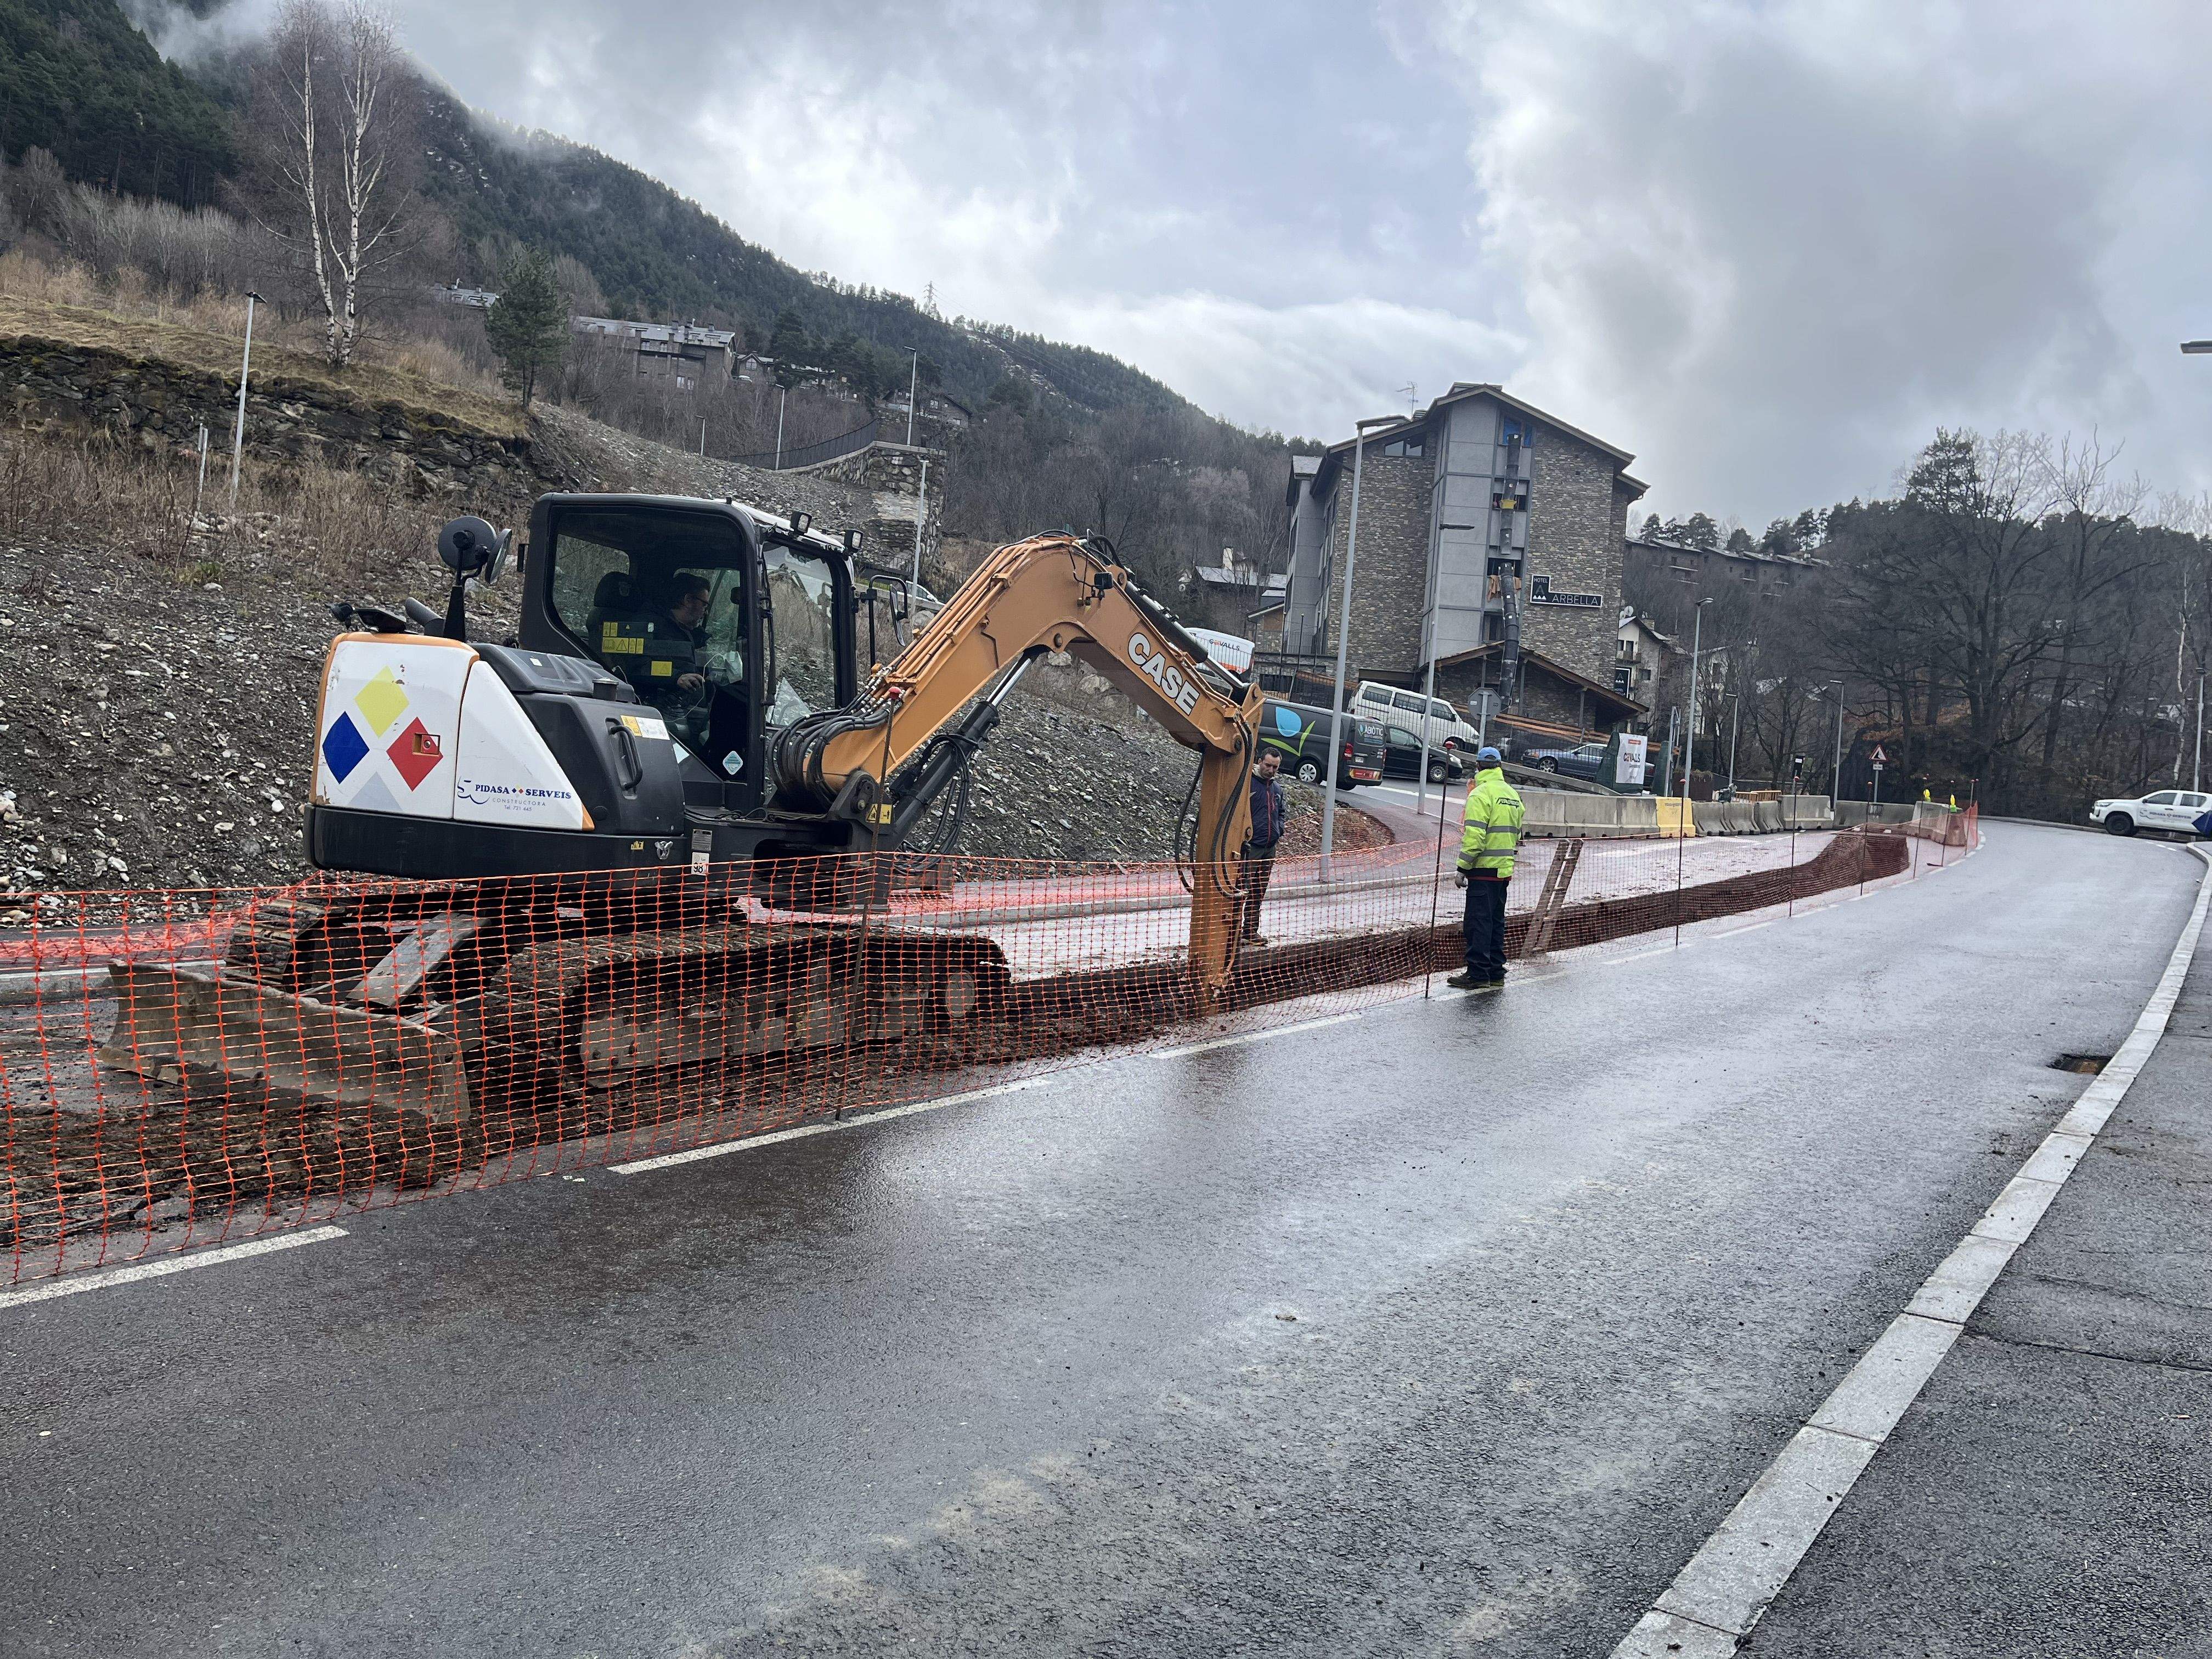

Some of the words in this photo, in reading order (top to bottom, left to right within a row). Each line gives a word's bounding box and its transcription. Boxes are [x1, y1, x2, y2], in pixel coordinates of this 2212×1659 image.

[1551, 594, 1599, 606] ARBELLA
[1128, 632, 1201, 716] CASE
[475, 784, 510, 795] PIDASA
[525, 788, 572, 799] SERVEIS
[492, 797, 546, 806] CONSTRUCTORA
[693, 862, 703, 873] 98
